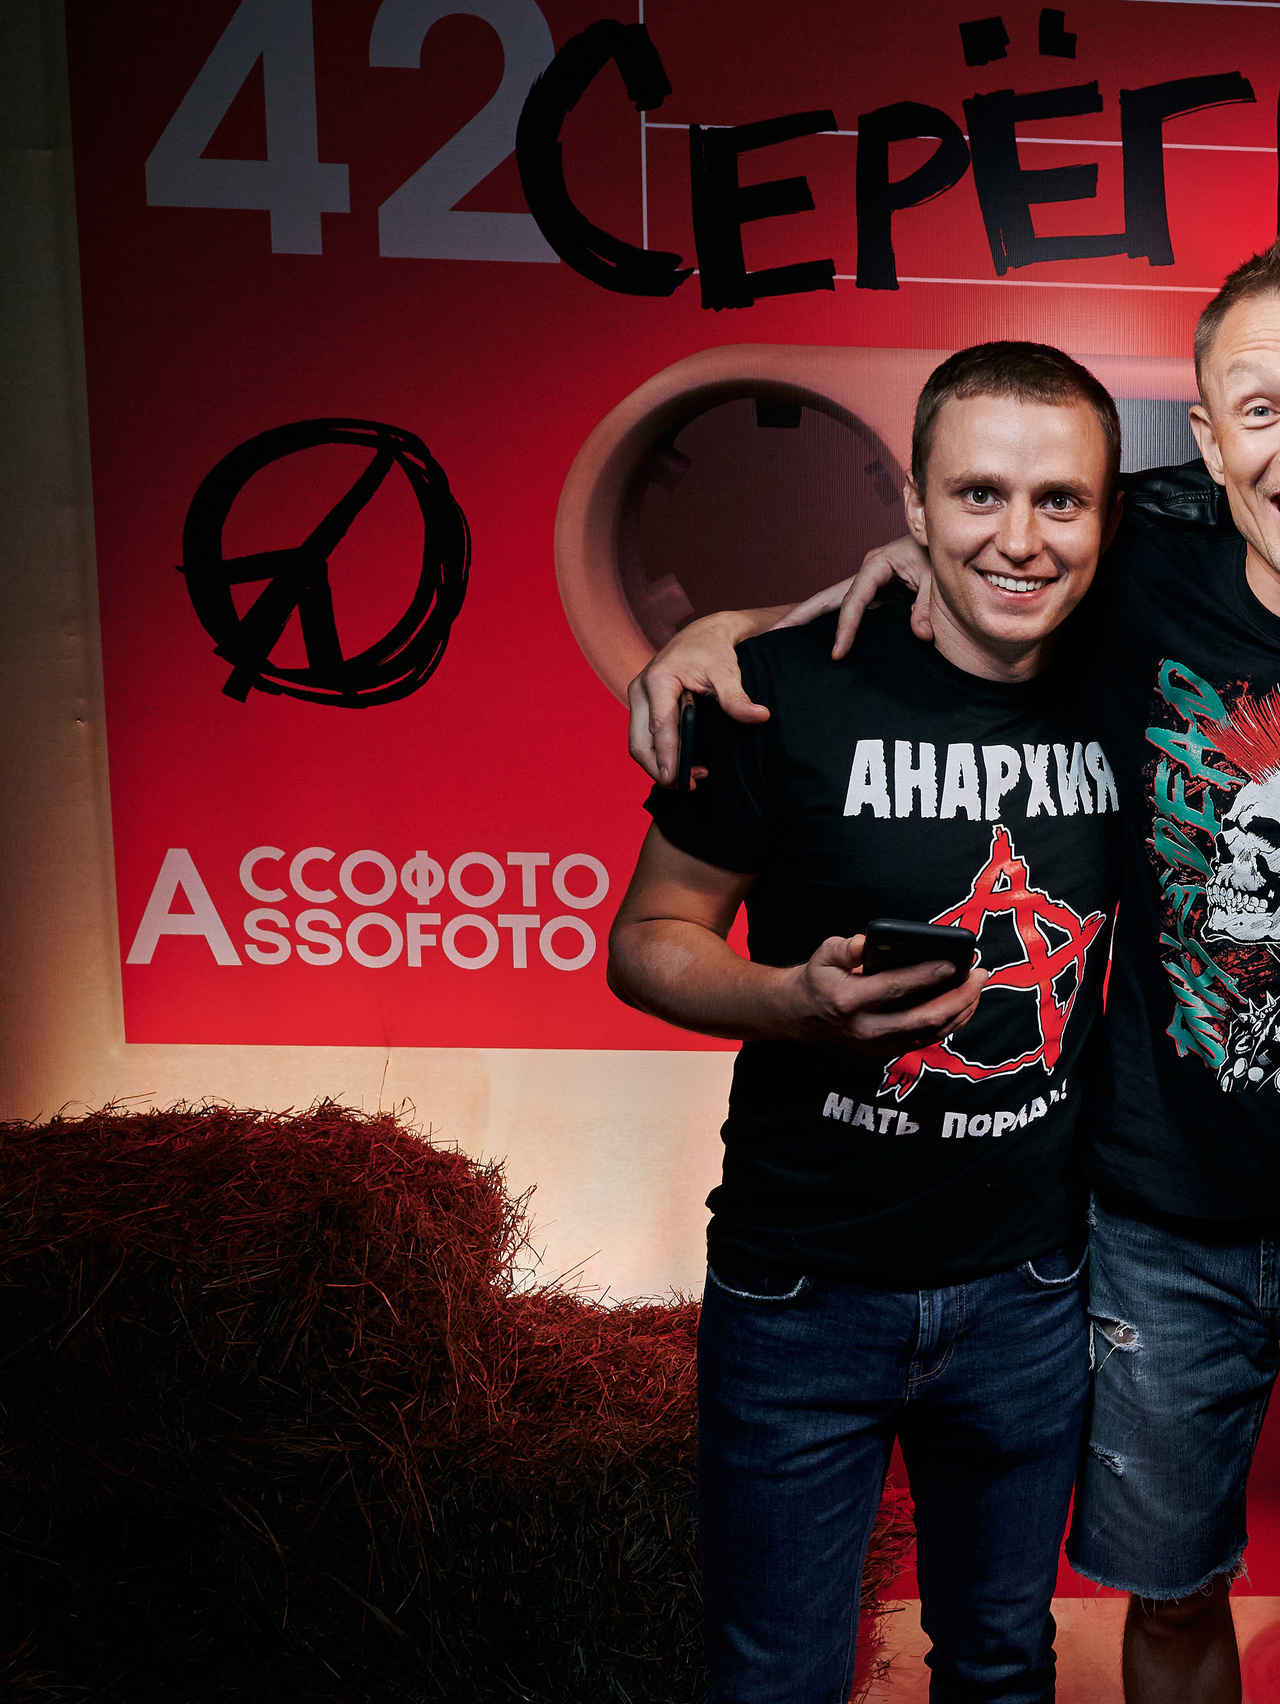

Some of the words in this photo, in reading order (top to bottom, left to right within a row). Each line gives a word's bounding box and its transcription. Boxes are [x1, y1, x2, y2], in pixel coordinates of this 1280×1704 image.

[145, 0, 562, 263] 42
[842, 739, 1120, 821] АНАРХИЯ
[822, 1092, 920, 1136] МАТЬ
